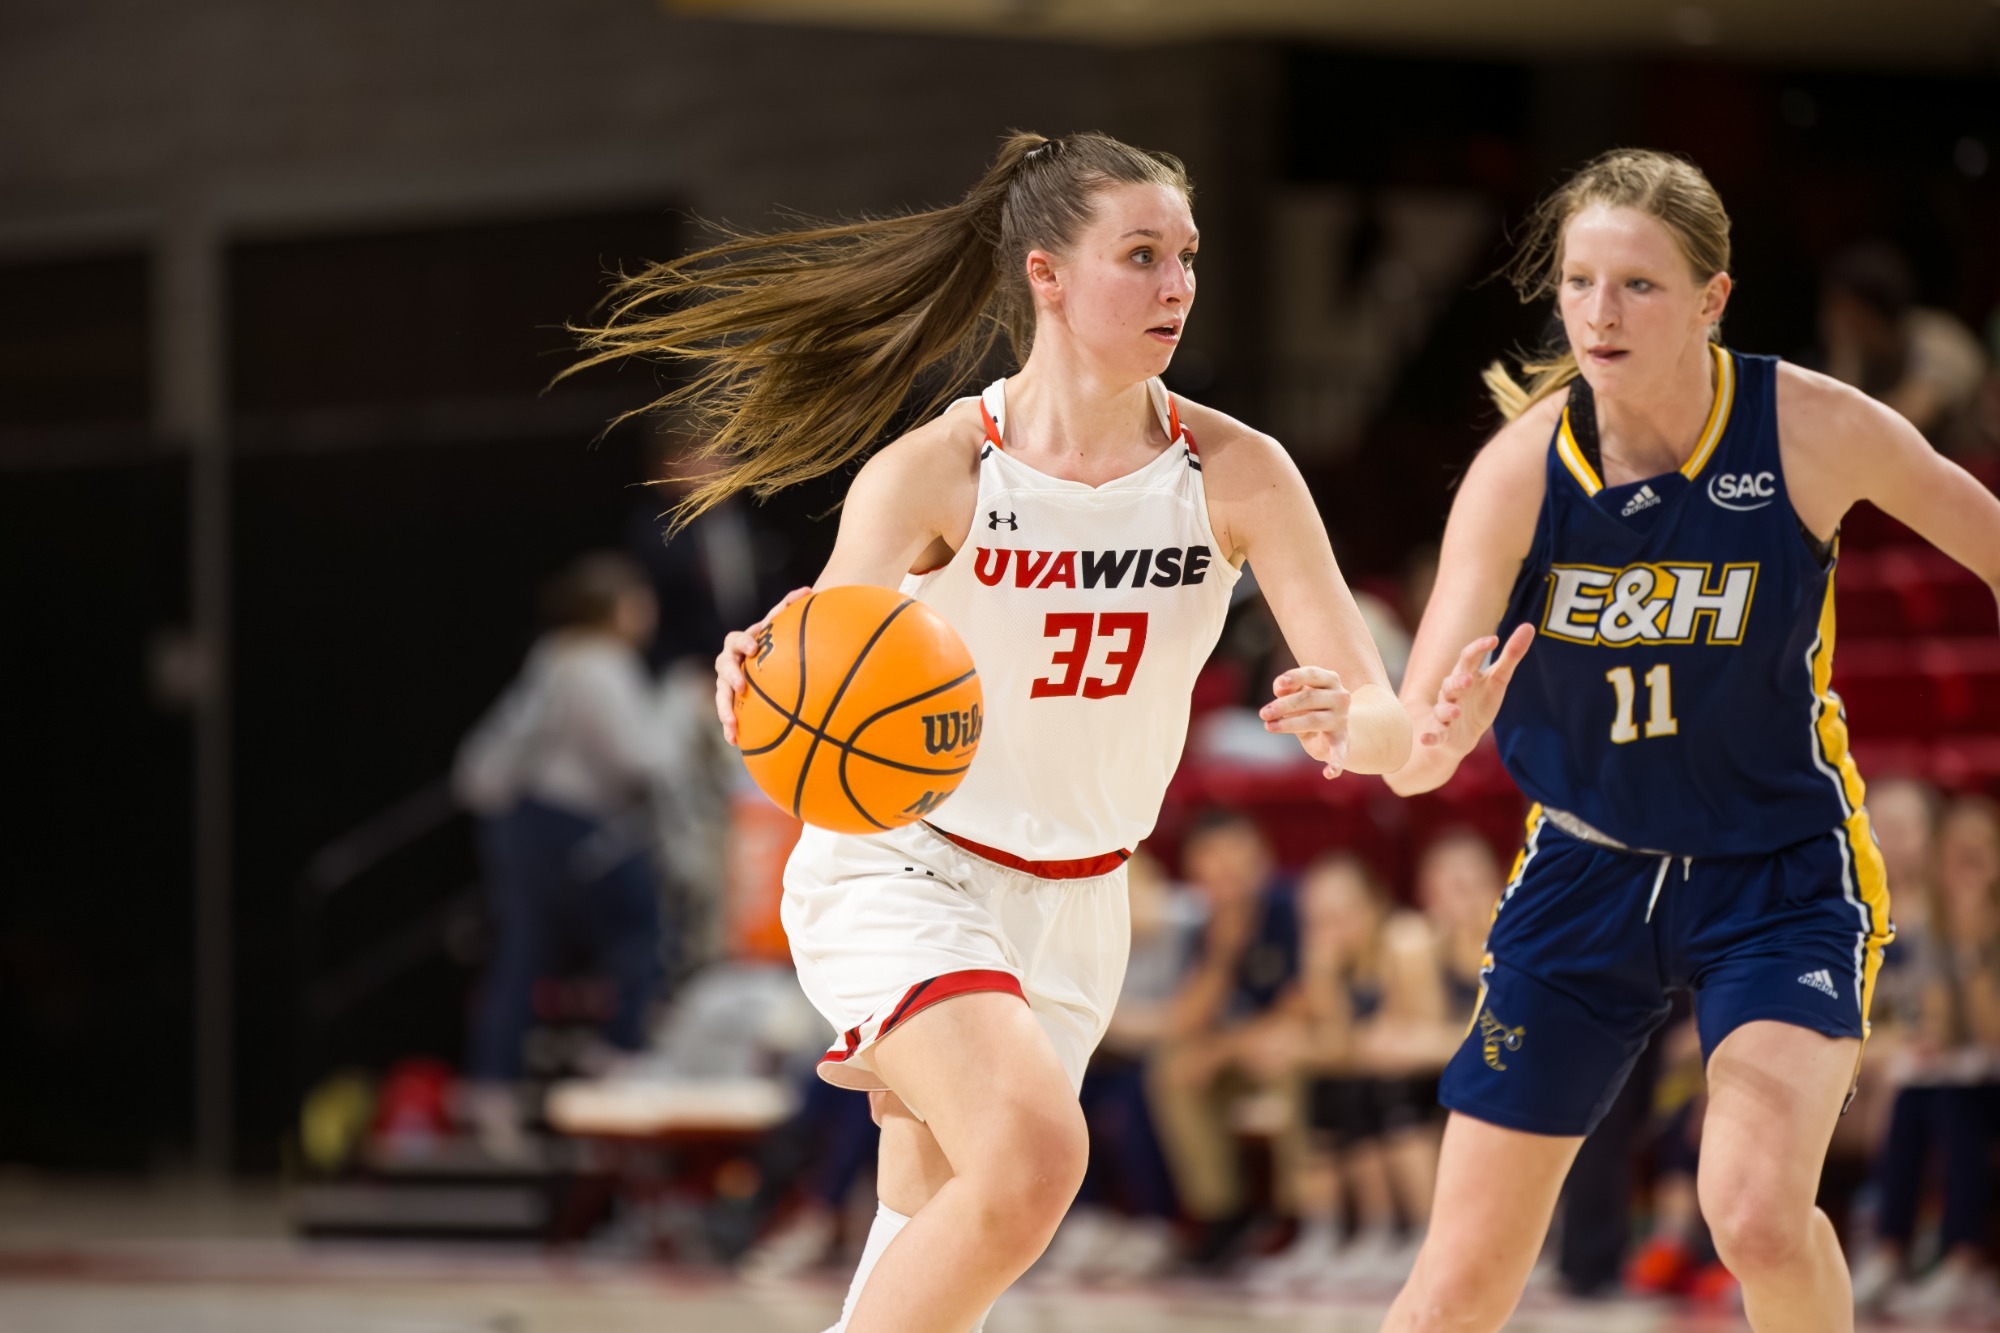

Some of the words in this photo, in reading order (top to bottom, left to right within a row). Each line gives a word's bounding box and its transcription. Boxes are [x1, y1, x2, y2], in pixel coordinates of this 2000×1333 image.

[1621, 495, 1661, 517] adidas
[1717, 471, 1775, 499] SAC
[1539, 562, 1760, 648] E&H
[1030, 612, 1149, 700] 33
[1605, 664, 1678, 744] 11
